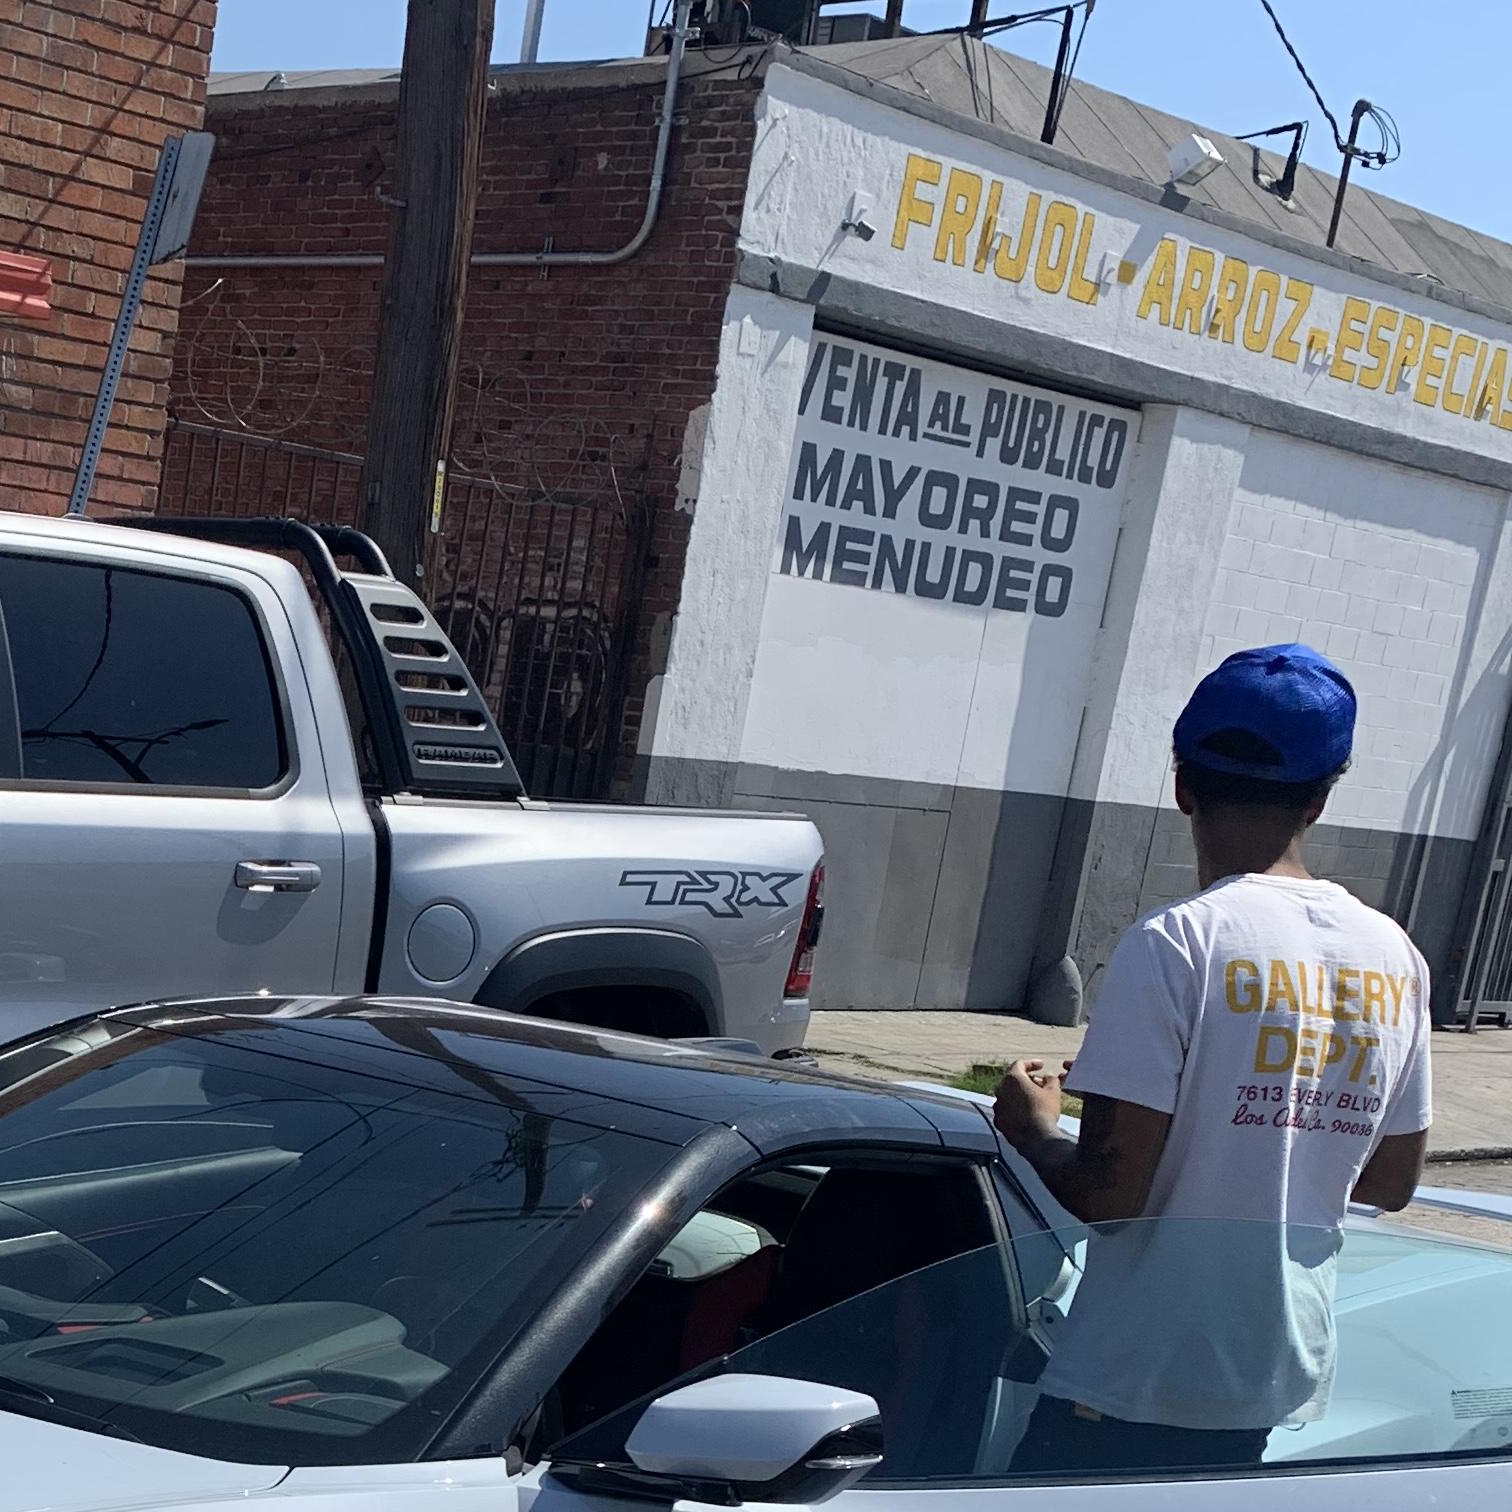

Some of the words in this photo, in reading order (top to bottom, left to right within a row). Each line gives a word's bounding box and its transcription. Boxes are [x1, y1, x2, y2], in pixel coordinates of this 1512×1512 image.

[891, 152, 1100, 306] FRIJOL
[1136, 237, 1314, 364] ARROZ
[927, 389, 971, 437] AL
[976, 387, 1127, 489] PUBLICO
[792, 440, 1080, 553] MAYOREO
[780, 514, 1073, 618] MENUDEO
[618, 870, 804, 918] TRX
[1224, 958, 1406, 1027] GALLERY
[1254, 1025, 1380, 1086] DEPT.
[1231, 1103, 1268, 1126] Los
[1236, 1085, 1283, 1102] 7613
[1336, 1092, 1381, 1113] BLVD
